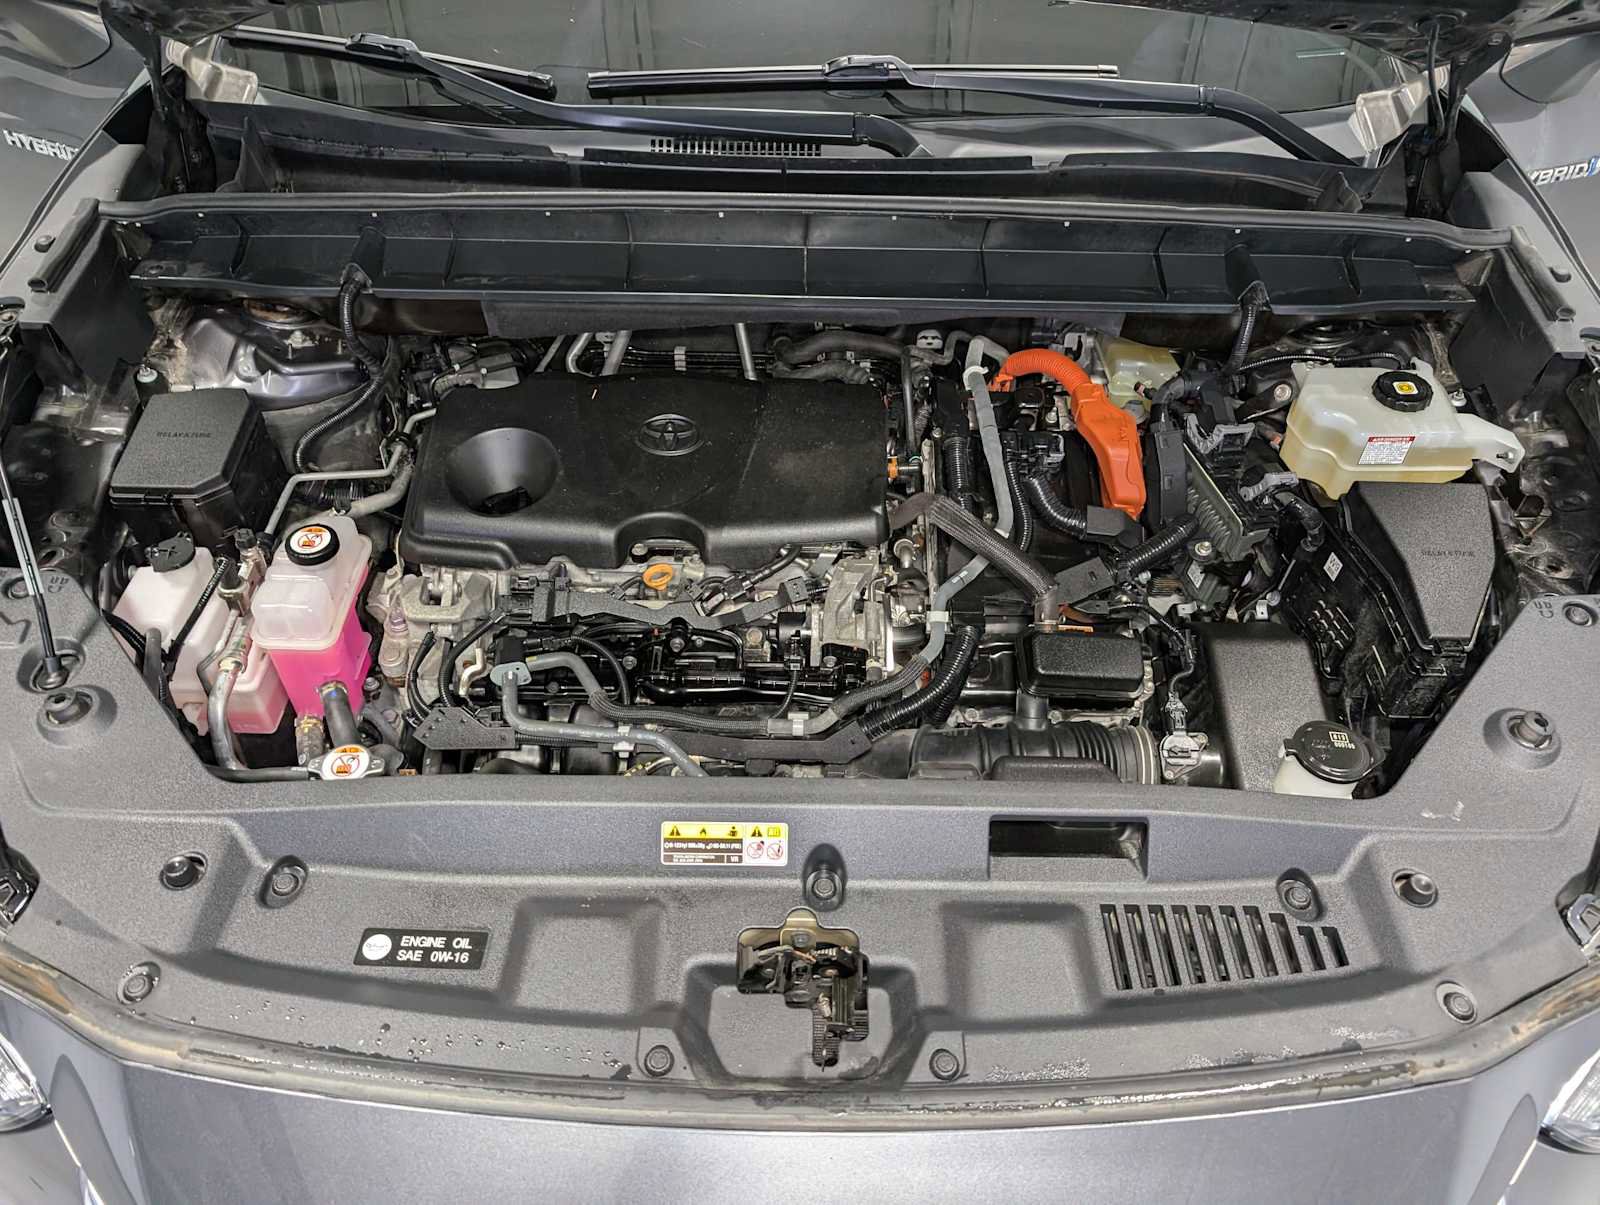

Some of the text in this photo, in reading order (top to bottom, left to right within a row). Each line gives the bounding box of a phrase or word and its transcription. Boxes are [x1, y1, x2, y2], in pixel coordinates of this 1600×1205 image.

[1527, 163, 1588, 186] YBRID
[400, 935, 472, 949] ENGINE OIL
[396, 950, 469, 963] SAE 0W-16
